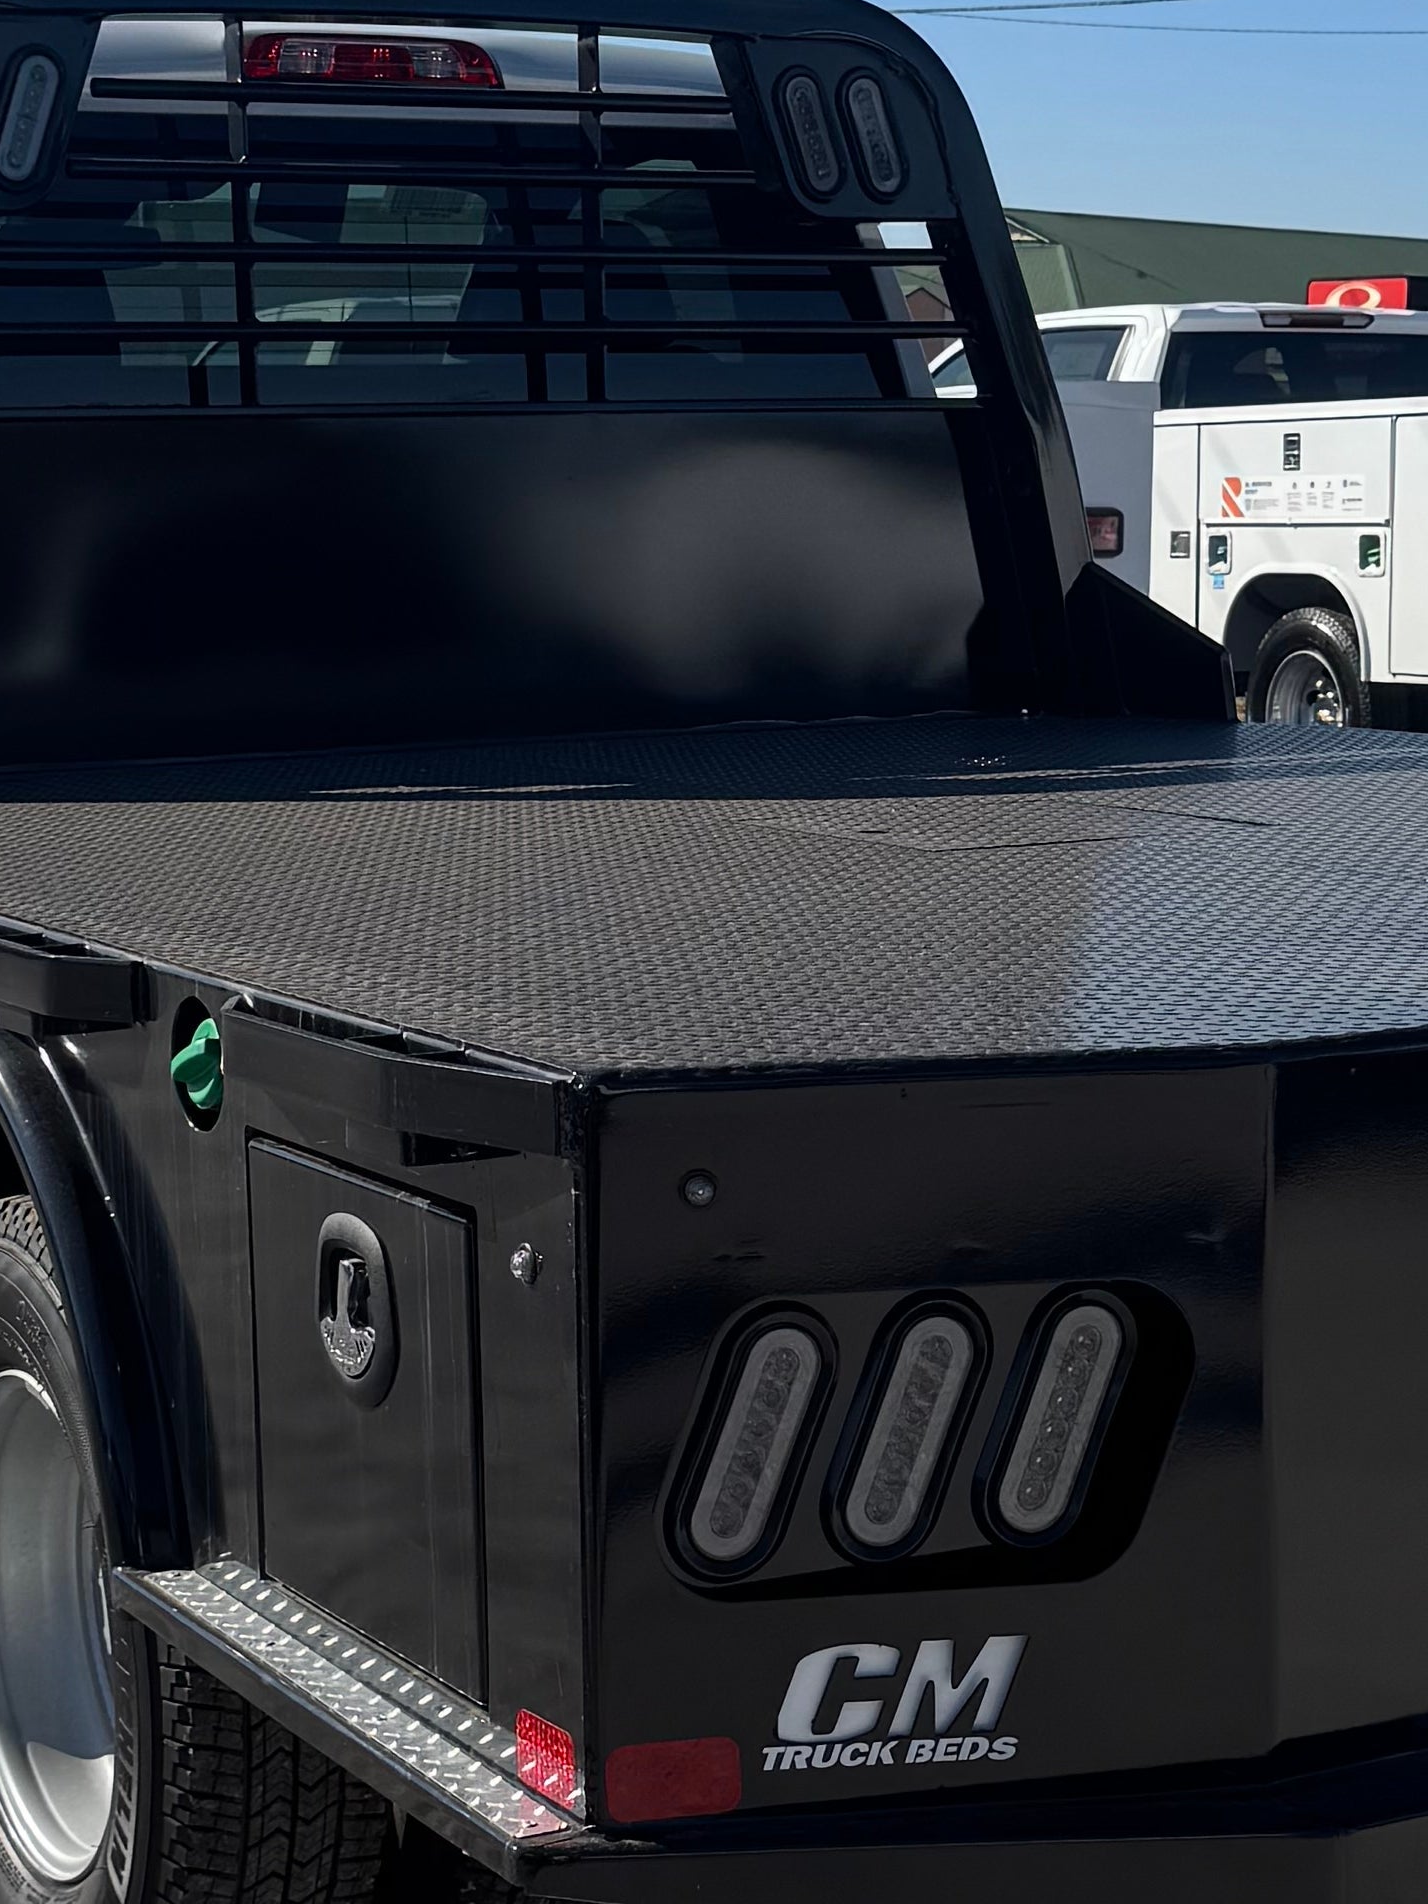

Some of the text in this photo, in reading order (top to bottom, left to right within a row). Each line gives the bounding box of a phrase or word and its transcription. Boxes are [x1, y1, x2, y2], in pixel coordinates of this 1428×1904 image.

[778, 1635, 1029, 1743] CM
[762, 1736, 1019, 1771] TRUCK BEDS
